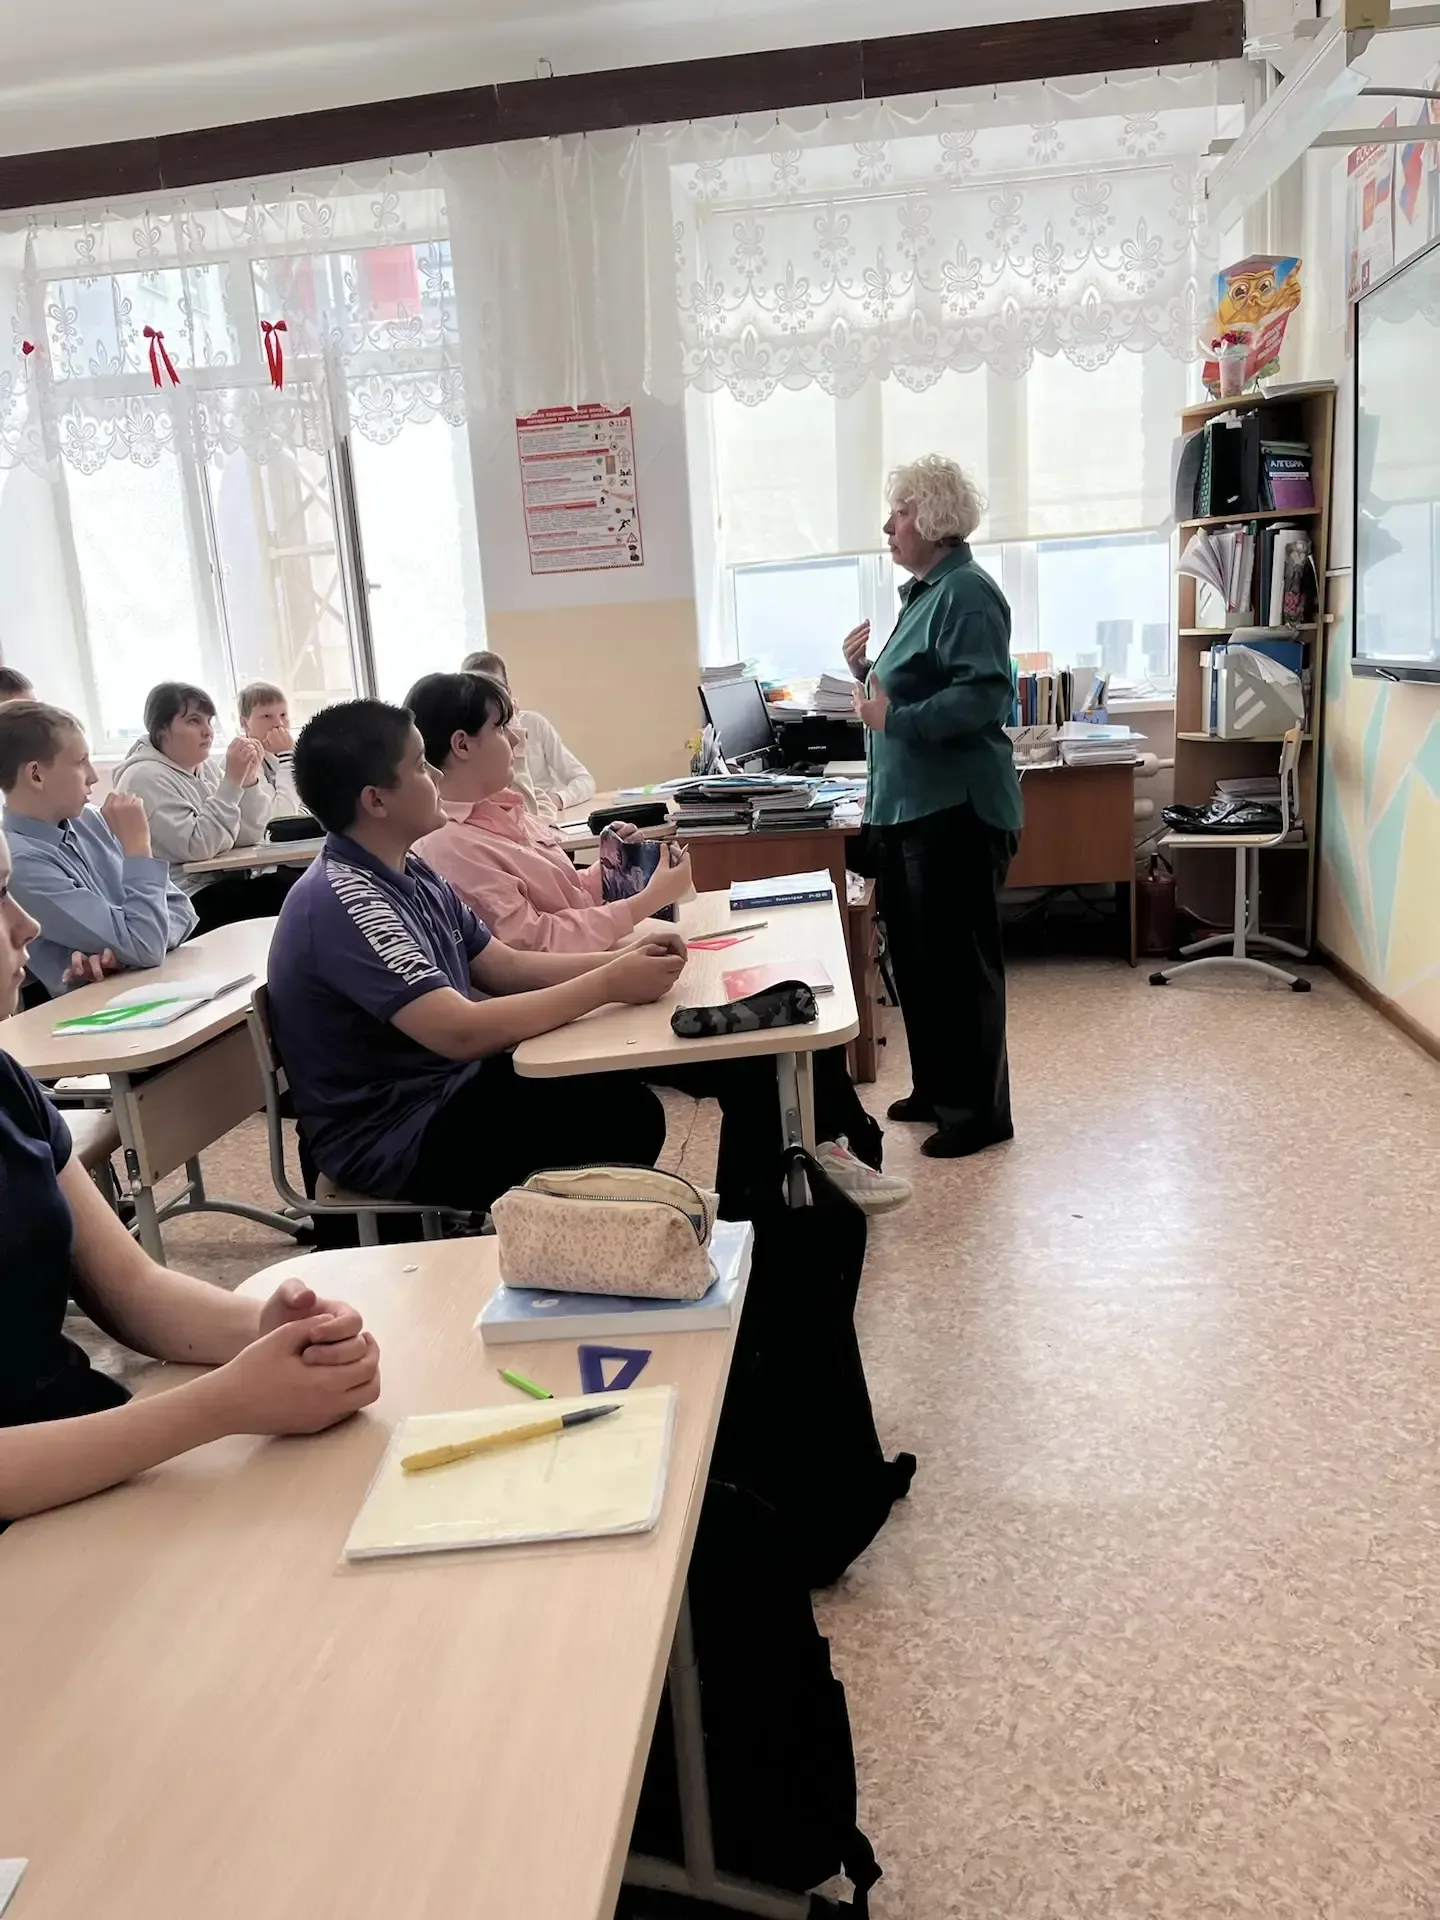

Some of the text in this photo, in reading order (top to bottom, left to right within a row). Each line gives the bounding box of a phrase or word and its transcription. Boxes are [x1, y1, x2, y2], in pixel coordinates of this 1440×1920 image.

[616, 419, 628, 427] 112
[1270, 459, 1305, 469] АЛГЕБРА
[347, 900, 435, 975] SOMETHING
